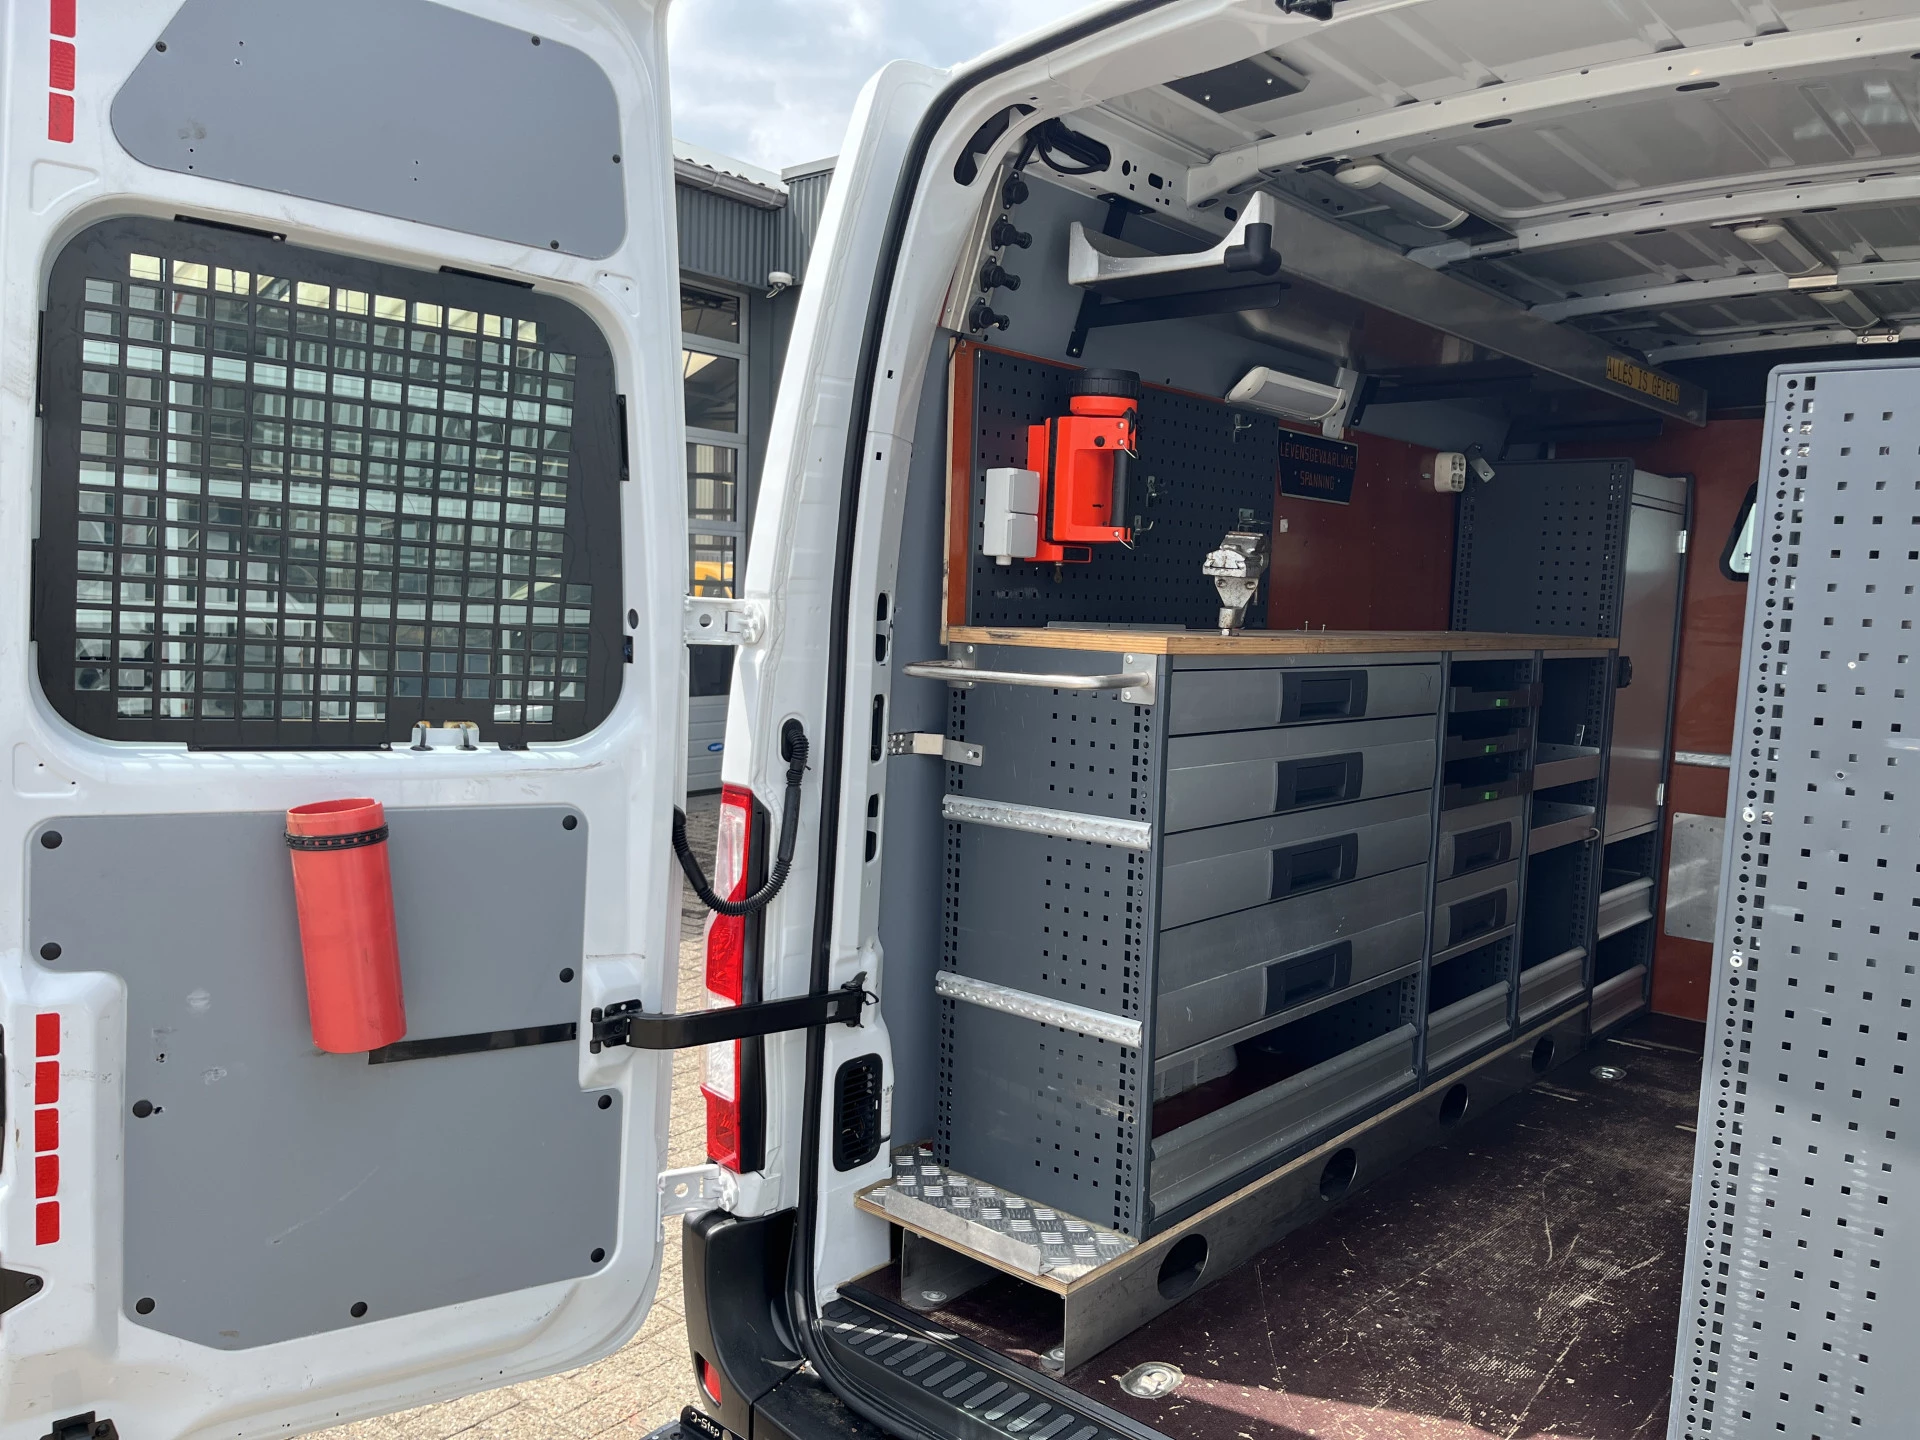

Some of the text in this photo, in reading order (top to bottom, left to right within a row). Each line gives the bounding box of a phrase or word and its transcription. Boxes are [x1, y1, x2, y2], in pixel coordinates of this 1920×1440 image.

[1607, 357, 1633, 386] ALLES
[1638, 370, 1648, 391] IS
[1299, 470, 1335, 490] SPANNING
